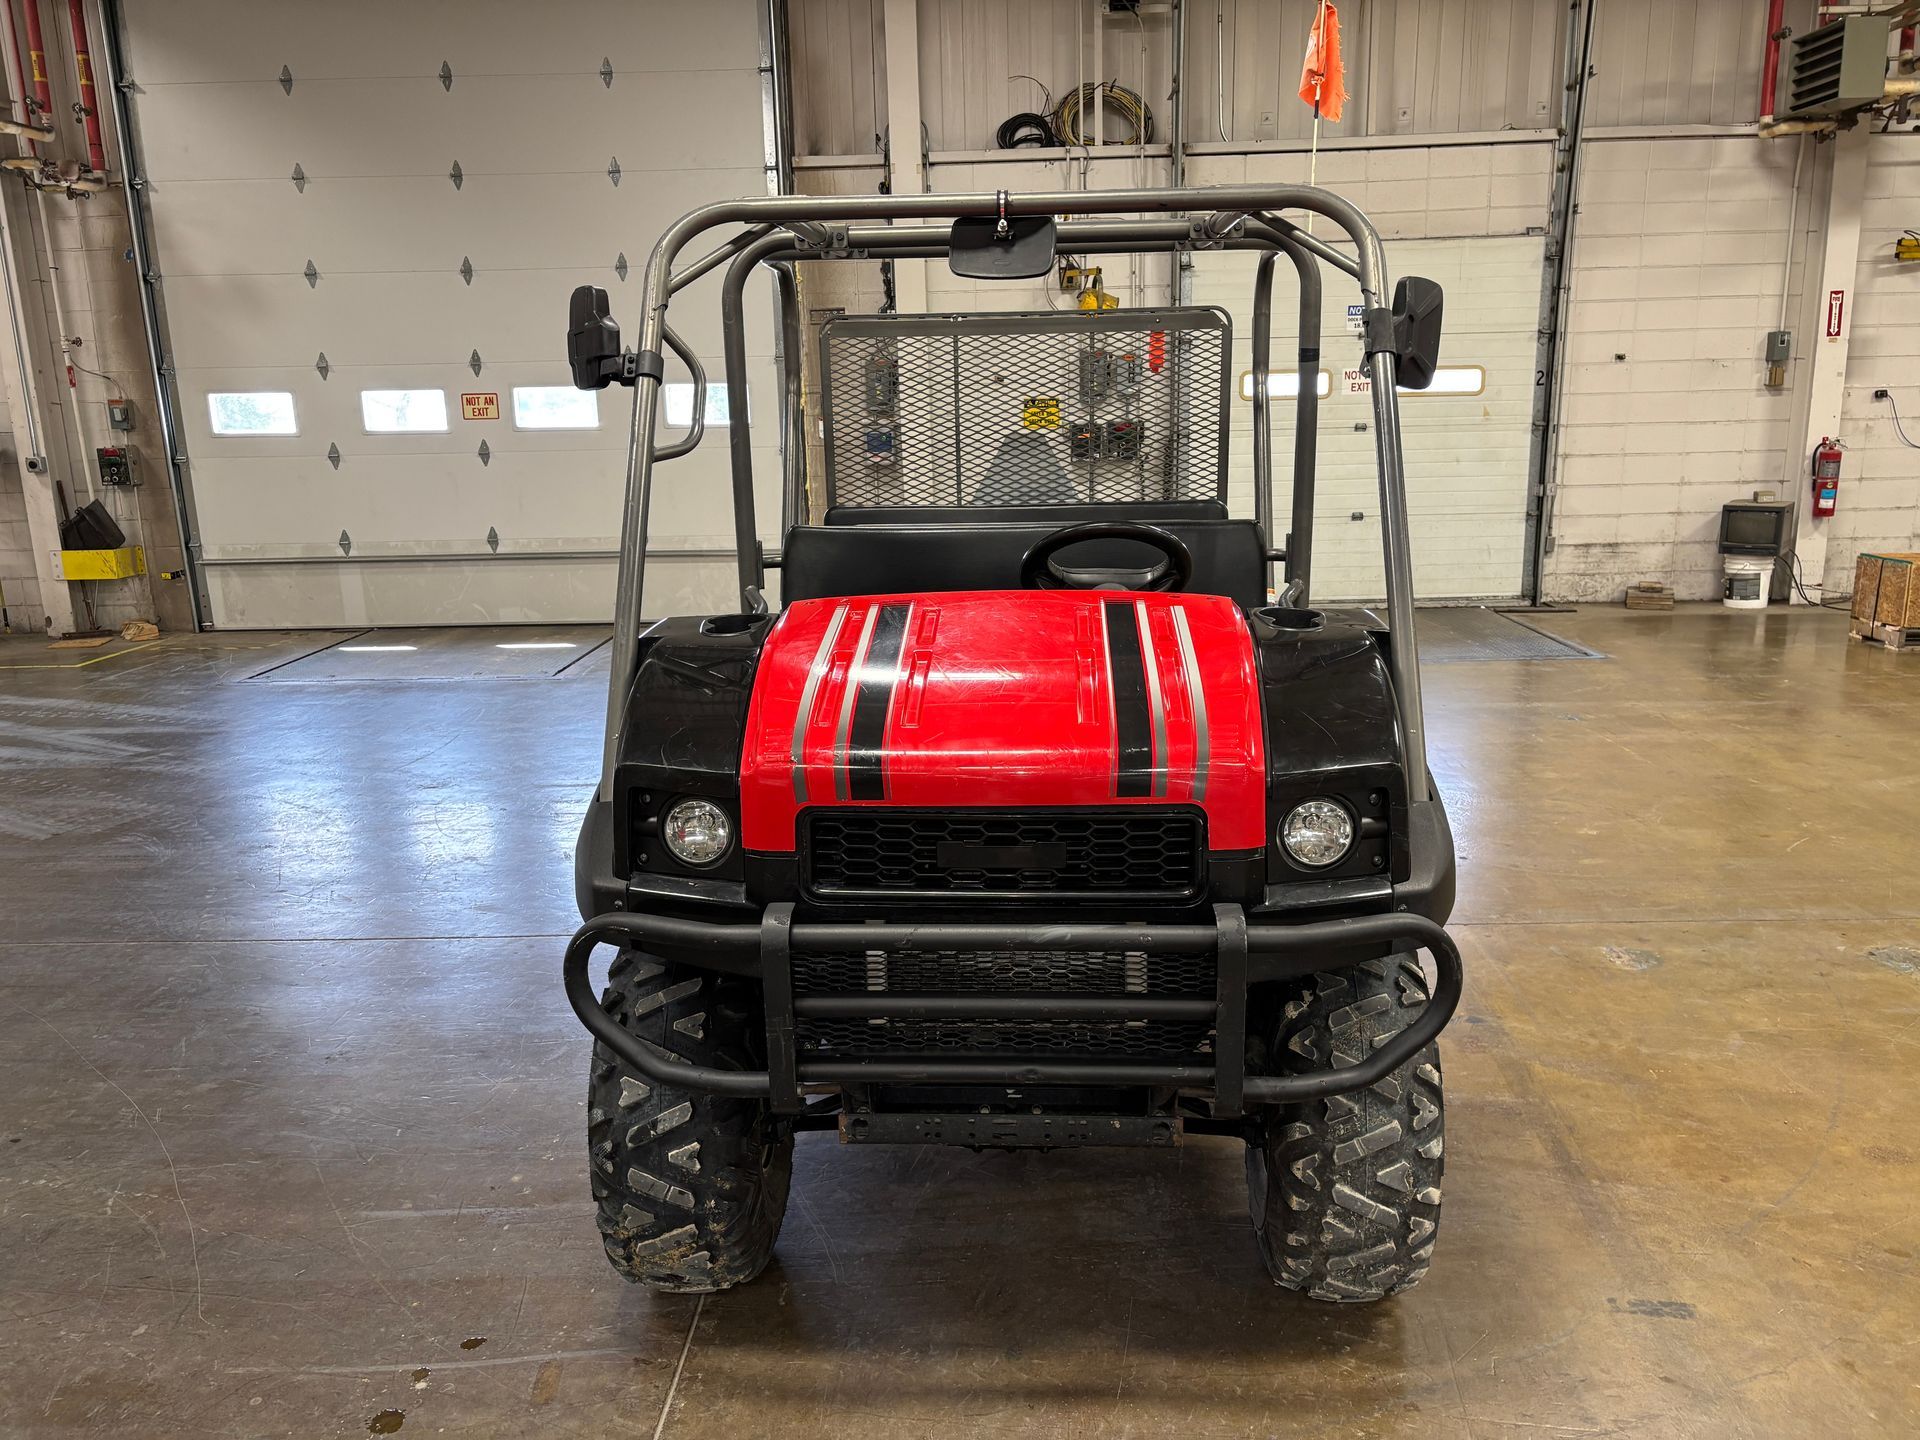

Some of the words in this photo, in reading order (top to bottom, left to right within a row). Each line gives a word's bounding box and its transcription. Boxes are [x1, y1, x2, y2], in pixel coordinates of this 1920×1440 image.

[1536, 370, 1544, 386] 2
[1351, 382, 1370, 392] EXIT
[466, 396, 480, 406] NOT
[484, 396, 494, 406] AN
[472, 408, 489, 416] EXIT
